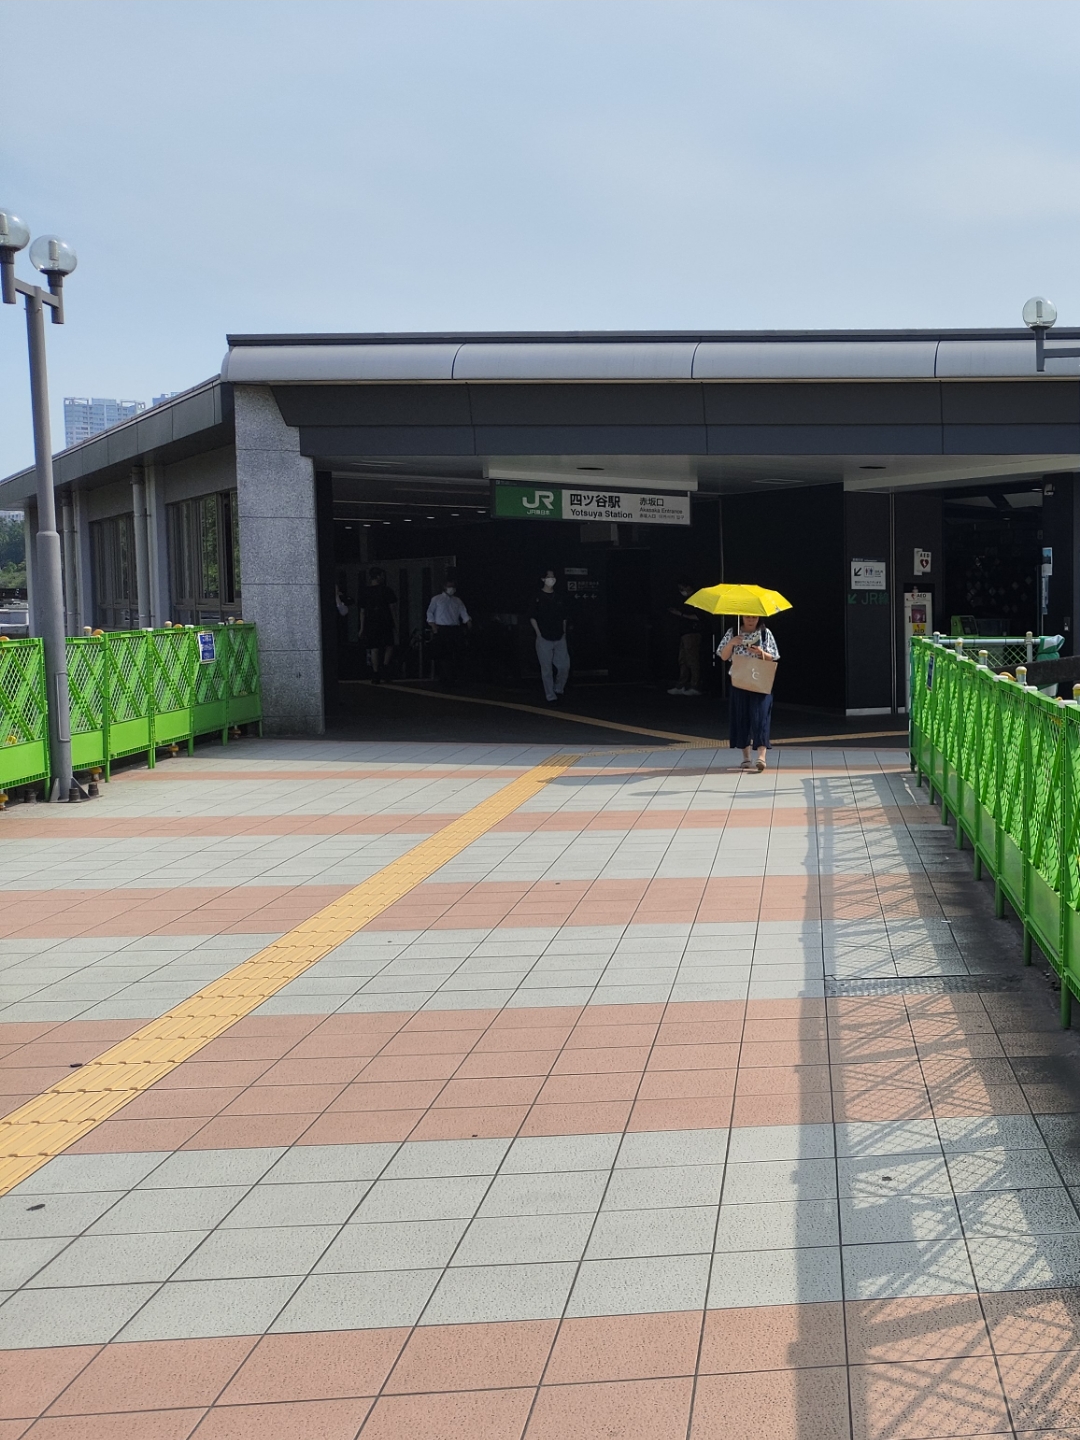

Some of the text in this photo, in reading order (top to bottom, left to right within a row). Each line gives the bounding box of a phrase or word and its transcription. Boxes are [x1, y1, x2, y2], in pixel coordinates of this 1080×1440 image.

[522, 490, 554, 509] JR
[570, 494, 621, 508] 四ツ谷駅
[639, 497, 664, 506] 赤坂口
[570, 508, 633, 519] Yotsuya Station
[861, 592, 889, 605] JR線
